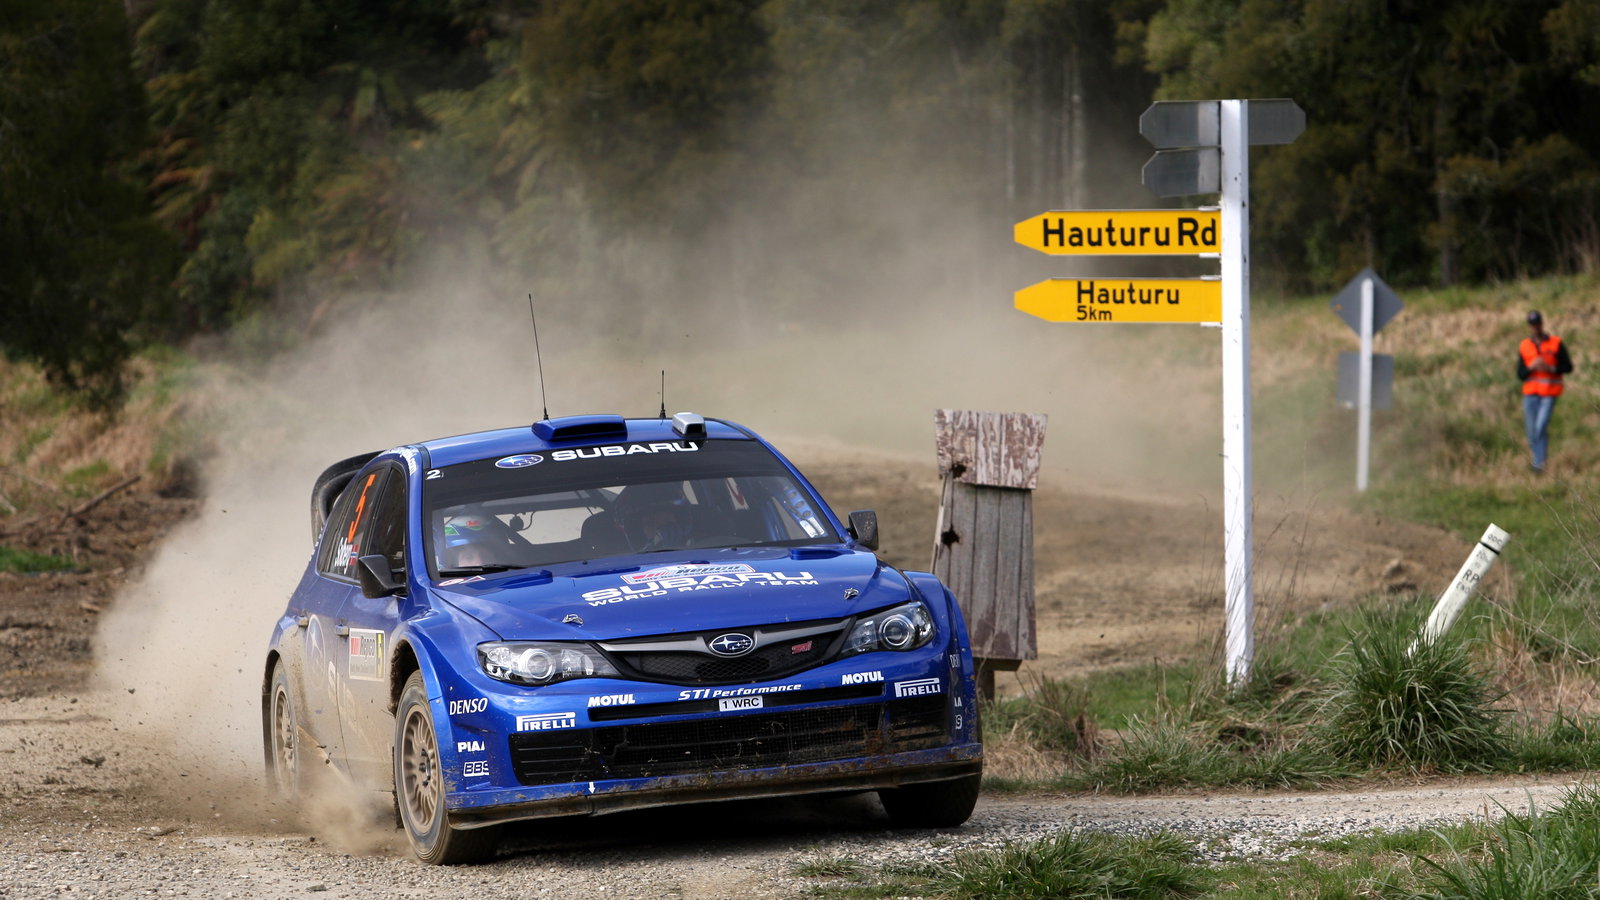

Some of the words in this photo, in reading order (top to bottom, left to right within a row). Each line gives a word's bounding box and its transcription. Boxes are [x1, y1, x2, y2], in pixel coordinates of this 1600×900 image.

[1043, 218, 1170, 246] Hauturu
[1178, 217, 1217, 246] Rd
[1077, 281, 1180, 304] Hauturu
[1077, 306, 1112, 320] 5km
[551, 441, 699, 461] SUBARU
[426, 469, 441, 480] 2
[582, 572, 814, 601] SUBARU
[588, 590, 668, 607] WORLD
[678, 581, 746, 592] RALLY
[841, 671, 884, 685] MOTUL
[894, 677, 941, 697] PIRELLI
[587, 694, 635, 707] MOTUL
[678, 689, 711, 701] STI
[712, 684, 802, 697] Performance
[449, 698, 488, 715] DENSO
[722, 701, 729, 709] 1
[732, 698, 760, 708] WRC
[516, 712, 576, 732] PIRELLI
